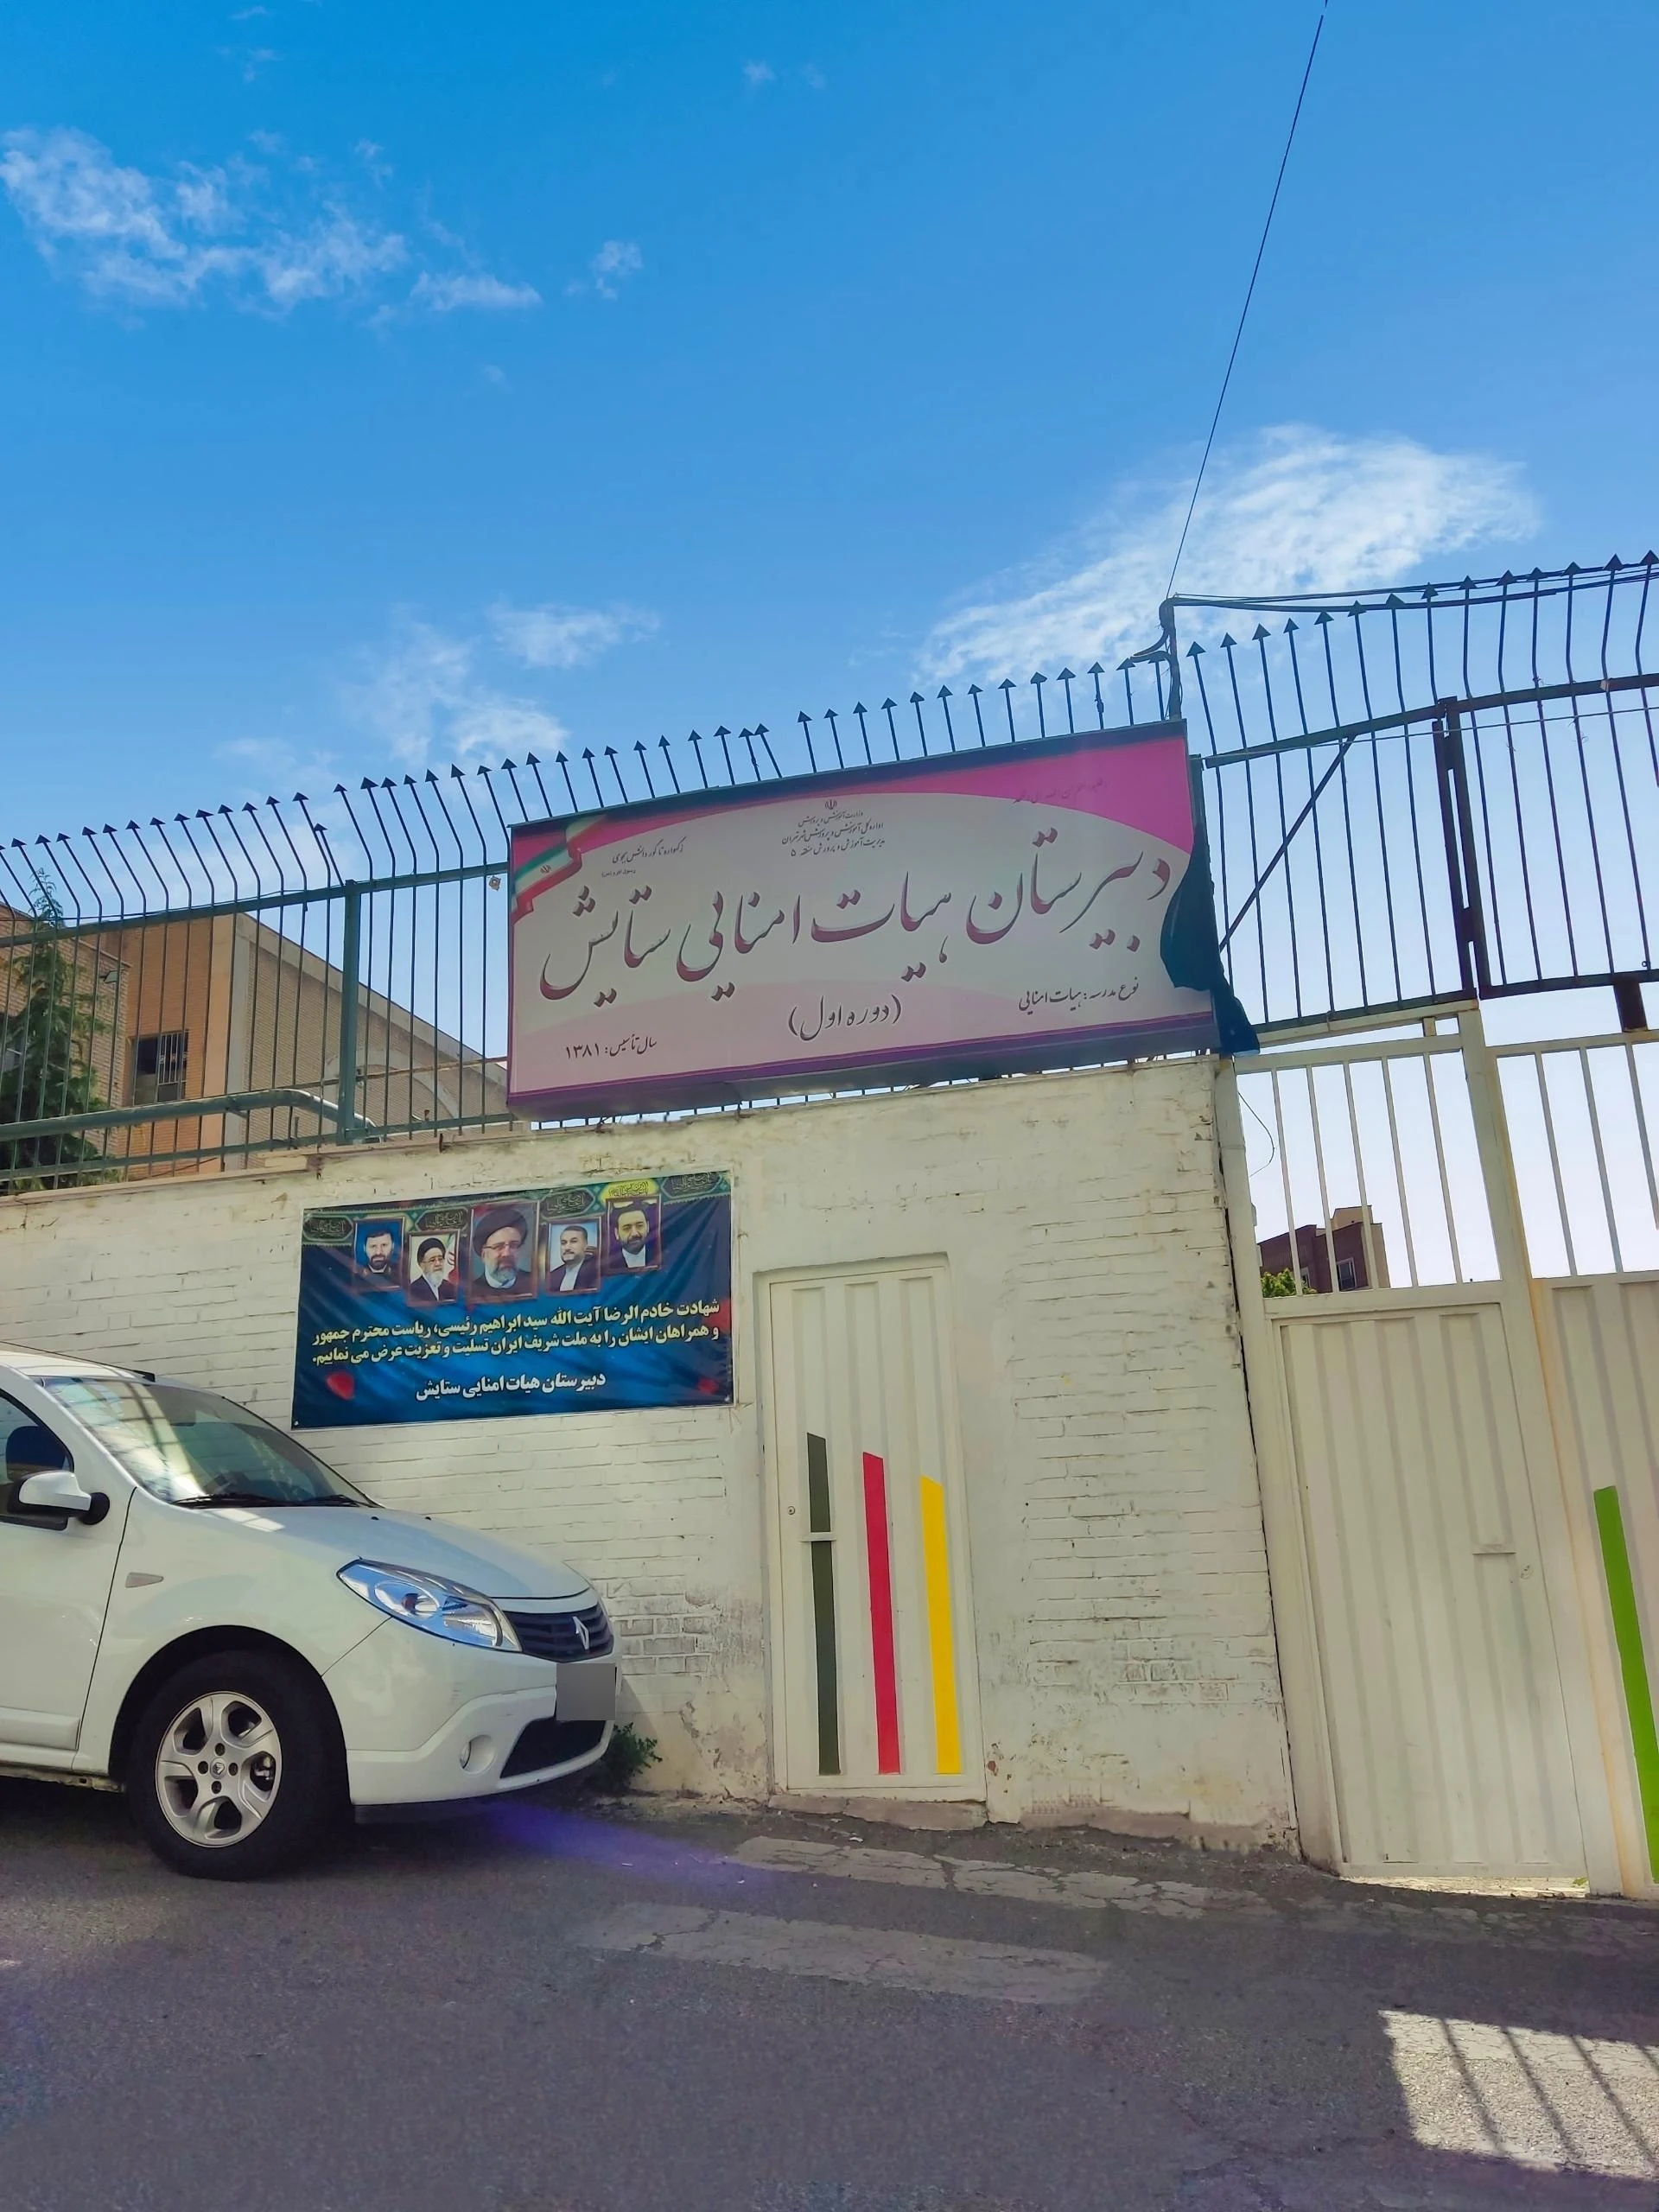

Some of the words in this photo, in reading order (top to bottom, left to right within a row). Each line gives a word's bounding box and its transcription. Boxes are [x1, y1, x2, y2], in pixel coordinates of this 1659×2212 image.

[813, 842, 836, 855] پرورش
[840, 837, 864, 851] آموزش
[965, 826, 1171, 953] دبیرستان
[810, 870, 952, 982] هیات
[538, 885, 671, 1008] ستایش
[1118, 976, 1140, 1001] نوع
[1049, 987, 1082, 1012] هیات
[566, 1043, 600, 1060] ۱۳۸۱
[636, 1036, 658, 1055] سال
[550, 1306, 572, 1325] الله
[573, 1306, 603, 1327] آیت
[603, 1304, 639, 1325] الرضا
[640, 1301, 674, 1323] خادم
[676, 1298, 721, 1318] شهادت
[391, 1320, 432, 1338] ریاست
[480, 1313, 522, 1336] ابراهیم
[523, 1314, 548, 1331] سید
[311, 1327, 350, 1346] جمهور
[352, 1324, 390, 1343] محترم
[524, 1333, 560, 1352] شریف
[561, 1332, 588, 1347] ملت
[589, 1332, 603, 1348] به
[604, 1329, 616, 1348] را
[618, 1325, 653, 1346] ایشان
[655, 1323, 709, 1344] همراهان
[711, 1326, 720, 1340] و
[371, 1344, 404, 1363] عرض
[404, 1341, 442, 1360] تعزیت
[442, 1344, 450, 1357] و
[452, 1337, 489, 1357] تسلیت
[490, 1336, 523, 1356] ایران
[350, 1349, 370, 1364] می
[416, 1377, 461, 1402] ستایش
[462, 1374, 505, 1398] امنایی
[505, 1374, 540, 1395] هیات
[541, 1371, 607, 1394] دبیرستان
